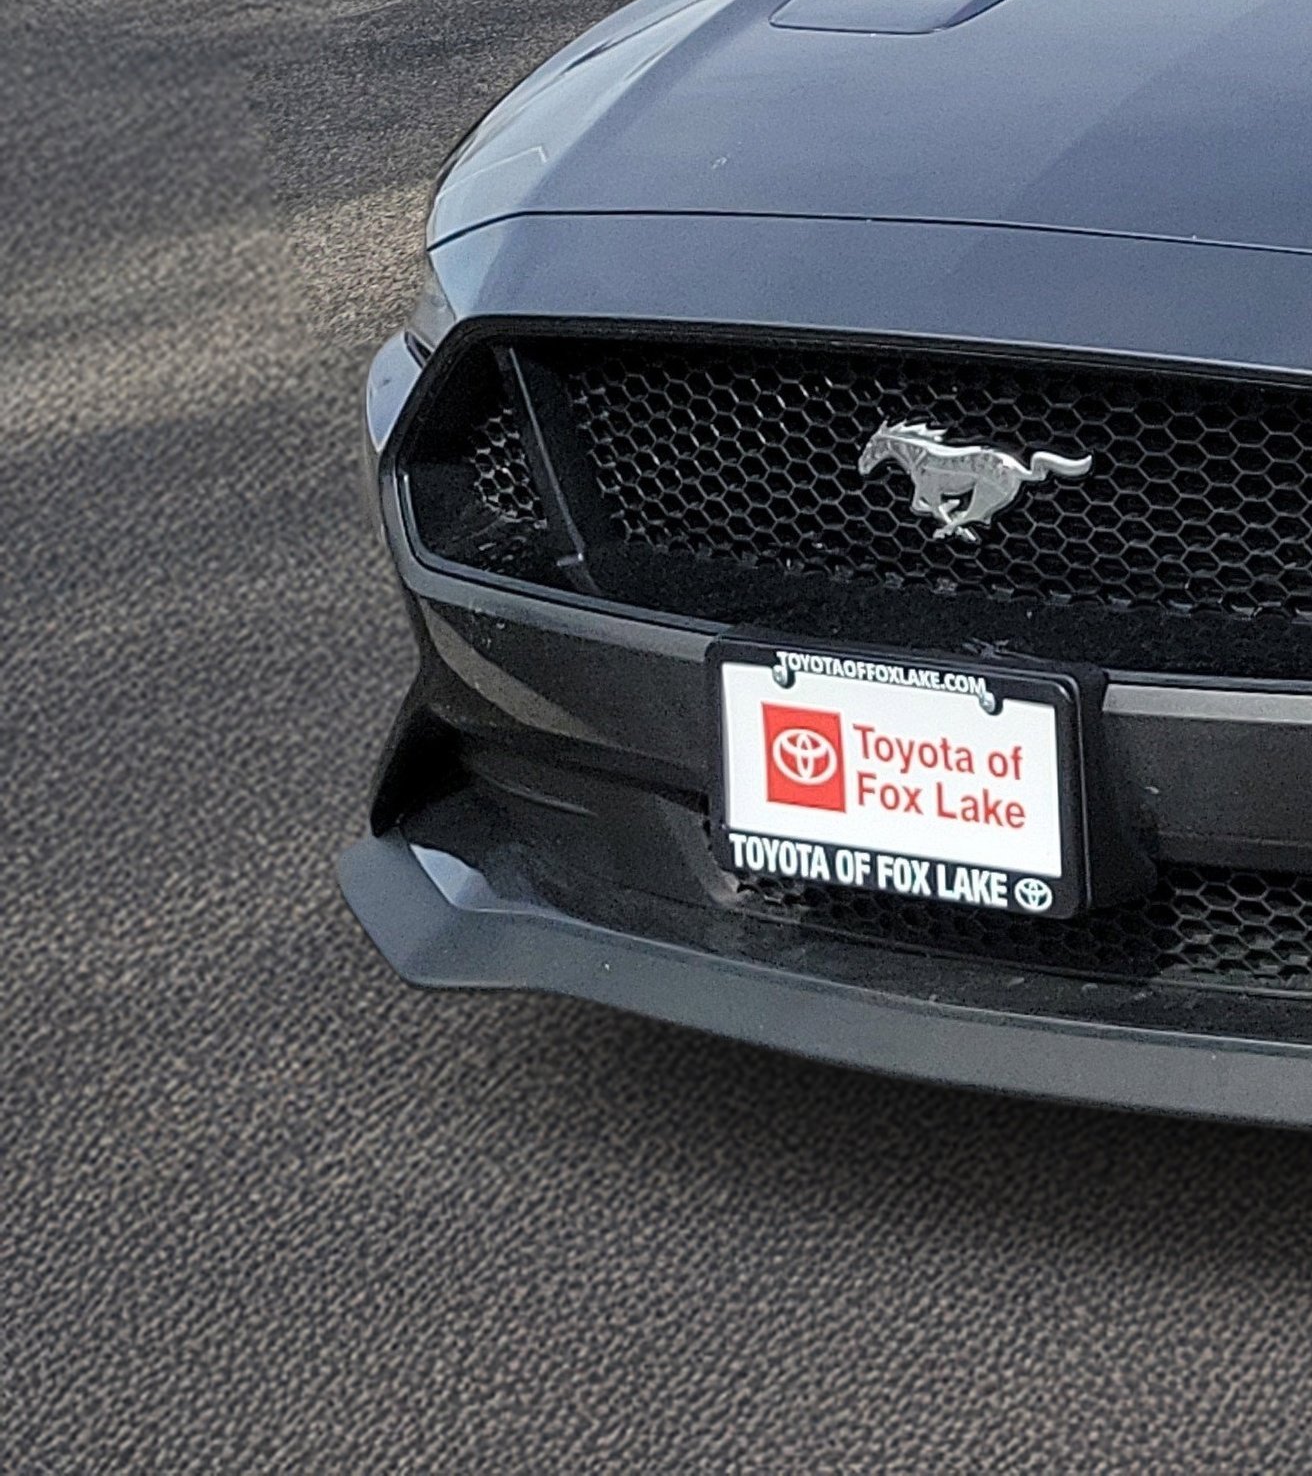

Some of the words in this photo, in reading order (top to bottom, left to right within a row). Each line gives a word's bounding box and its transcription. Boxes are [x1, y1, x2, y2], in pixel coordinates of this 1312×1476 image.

[776, 650, 987, 695] TOYOTAOFFOXLAKE.COM
[853, 723, 974, 774] Toyota
[988, 746, 1023, 780] of
[857, 770, 924, 815] Fox
[936, 782, 1026, 829] Lake
[728, 833, 829, 882] TOYOTA
[835, 849, 871, 888] OF
[877, 854, 931, 896] FOX
[936, 863, 1009, 908] LAKE
